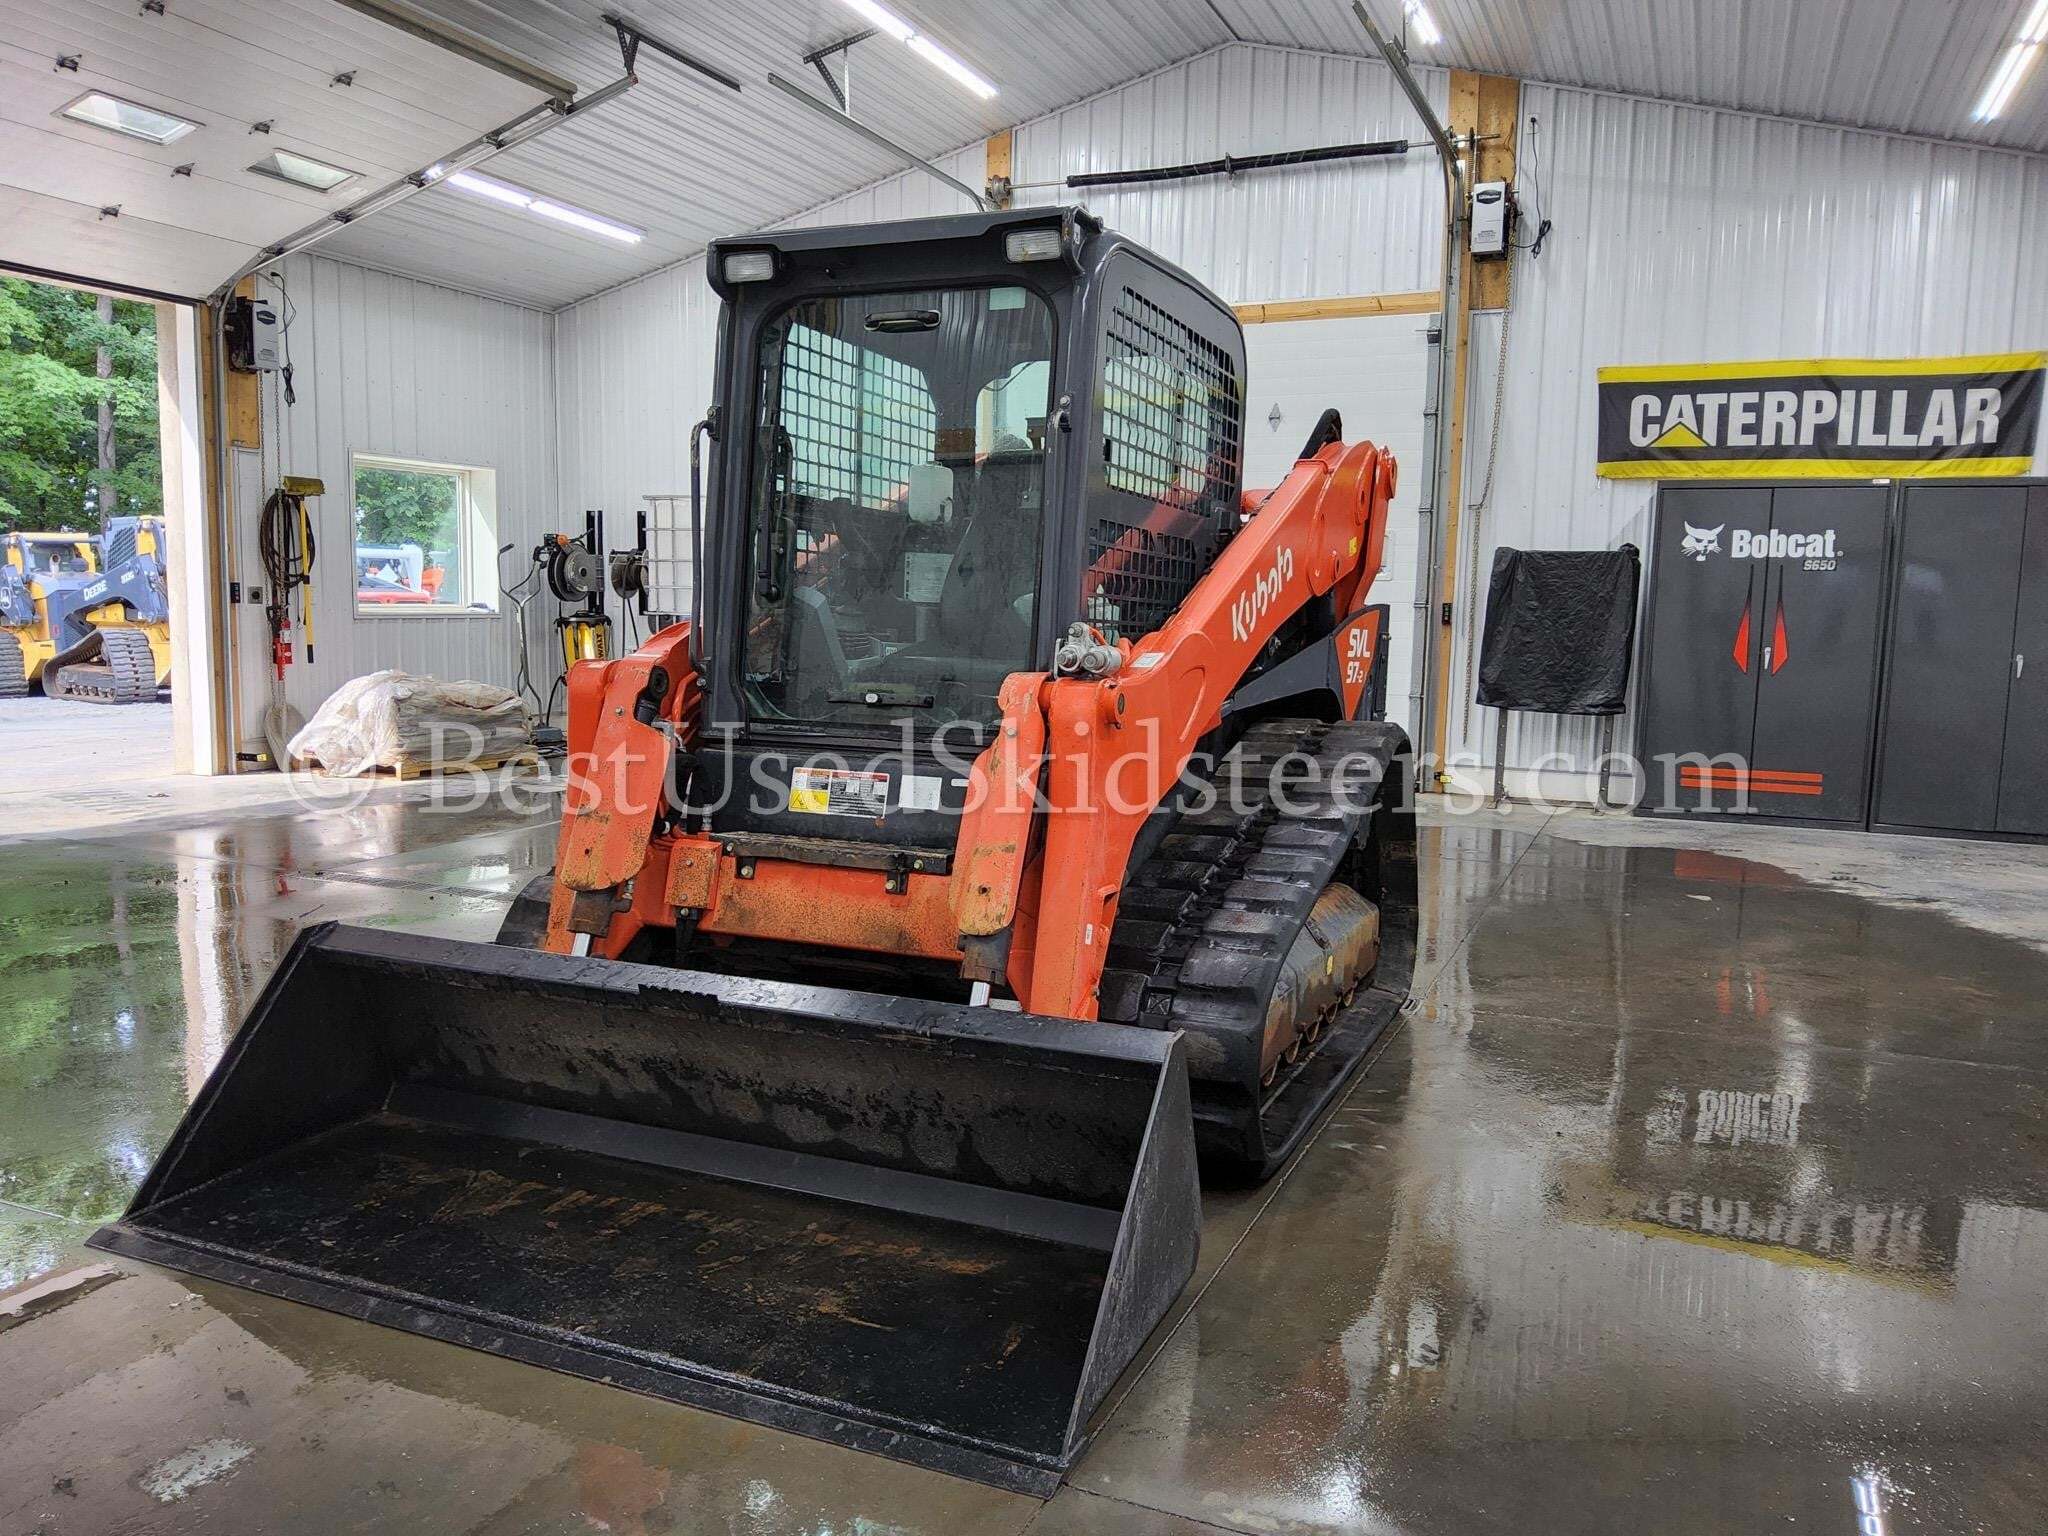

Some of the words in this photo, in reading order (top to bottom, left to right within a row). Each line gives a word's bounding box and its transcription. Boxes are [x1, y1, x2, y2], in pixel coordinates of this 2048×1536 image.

[1629, 388, 2002, 448] CATERPILLAR
[1731, 529, 1837, 559] Bobcat
[1803, 560, 1837, 571] S650
[83, 579, 108, 601] DEERE
[1232, 544, 1293, 643] Kubota
[596, 631, 605, 659] WALT
[1347, 628, 1371, 658] SVL
